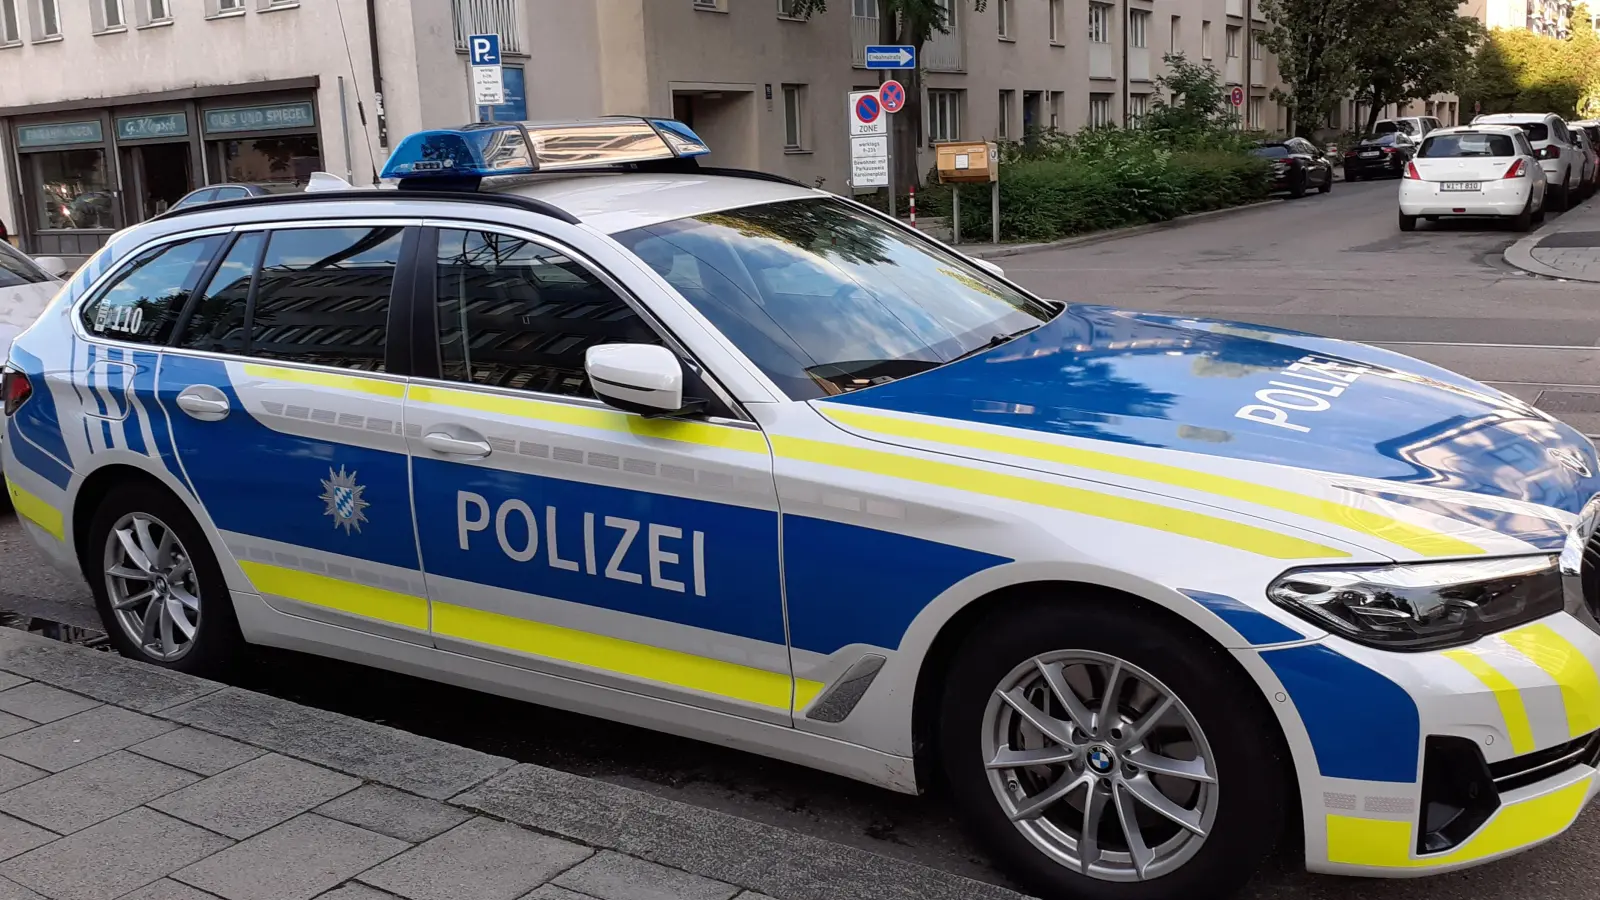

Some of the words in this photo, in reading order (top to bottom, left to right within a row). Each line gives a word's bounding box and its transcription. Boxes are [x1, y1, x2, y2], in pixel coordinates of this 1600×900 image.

[473, 38, 491, 62] P
[240, 111, 263, 124] UND
[266, 107, 308, 122] SPIEGEL
[859, 125, 878, 133] ZONE
[111, 305, 143, 334] 110
[1234, 354, 1372, 433] POLIZEI
[457, 489, 706, 597] POLIZEI
